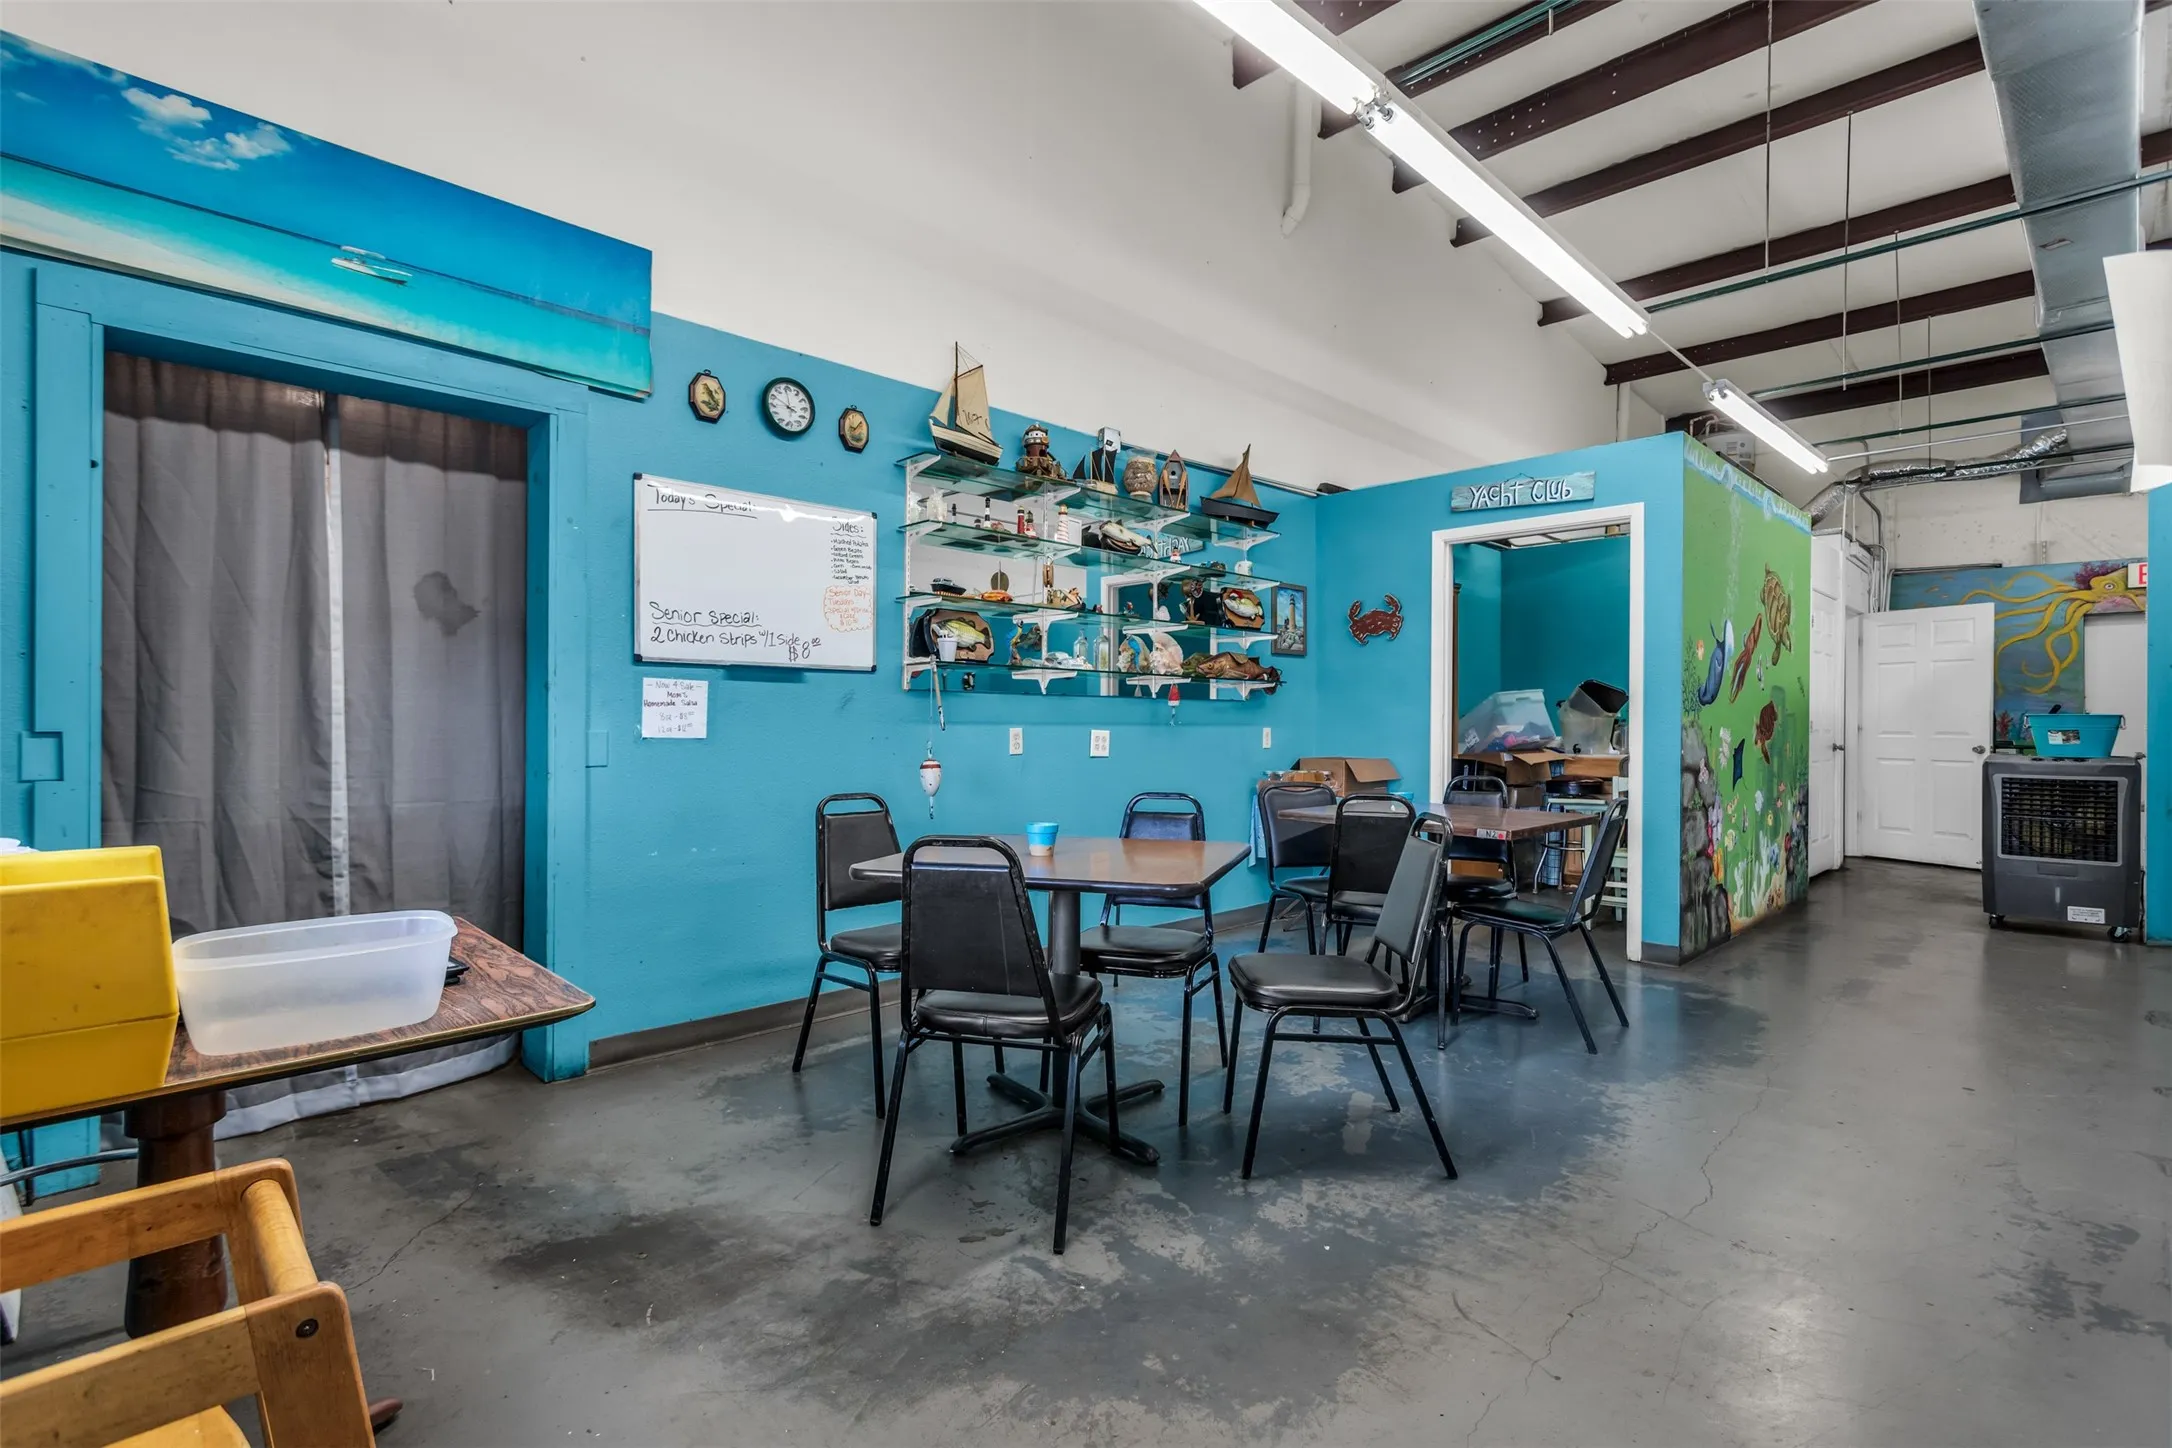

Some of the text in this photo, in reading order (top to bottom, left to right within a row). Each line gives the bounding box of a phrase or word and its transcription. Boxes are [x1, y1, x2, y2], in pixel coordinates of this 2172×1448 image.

[649, 601, 702, 624] Senior
[650, 626, 665, 643] 2
[666, 628, 714, 644] Chicken
[719, 632, 758, 648] Strips
[777, 633, 801, 646] Side
